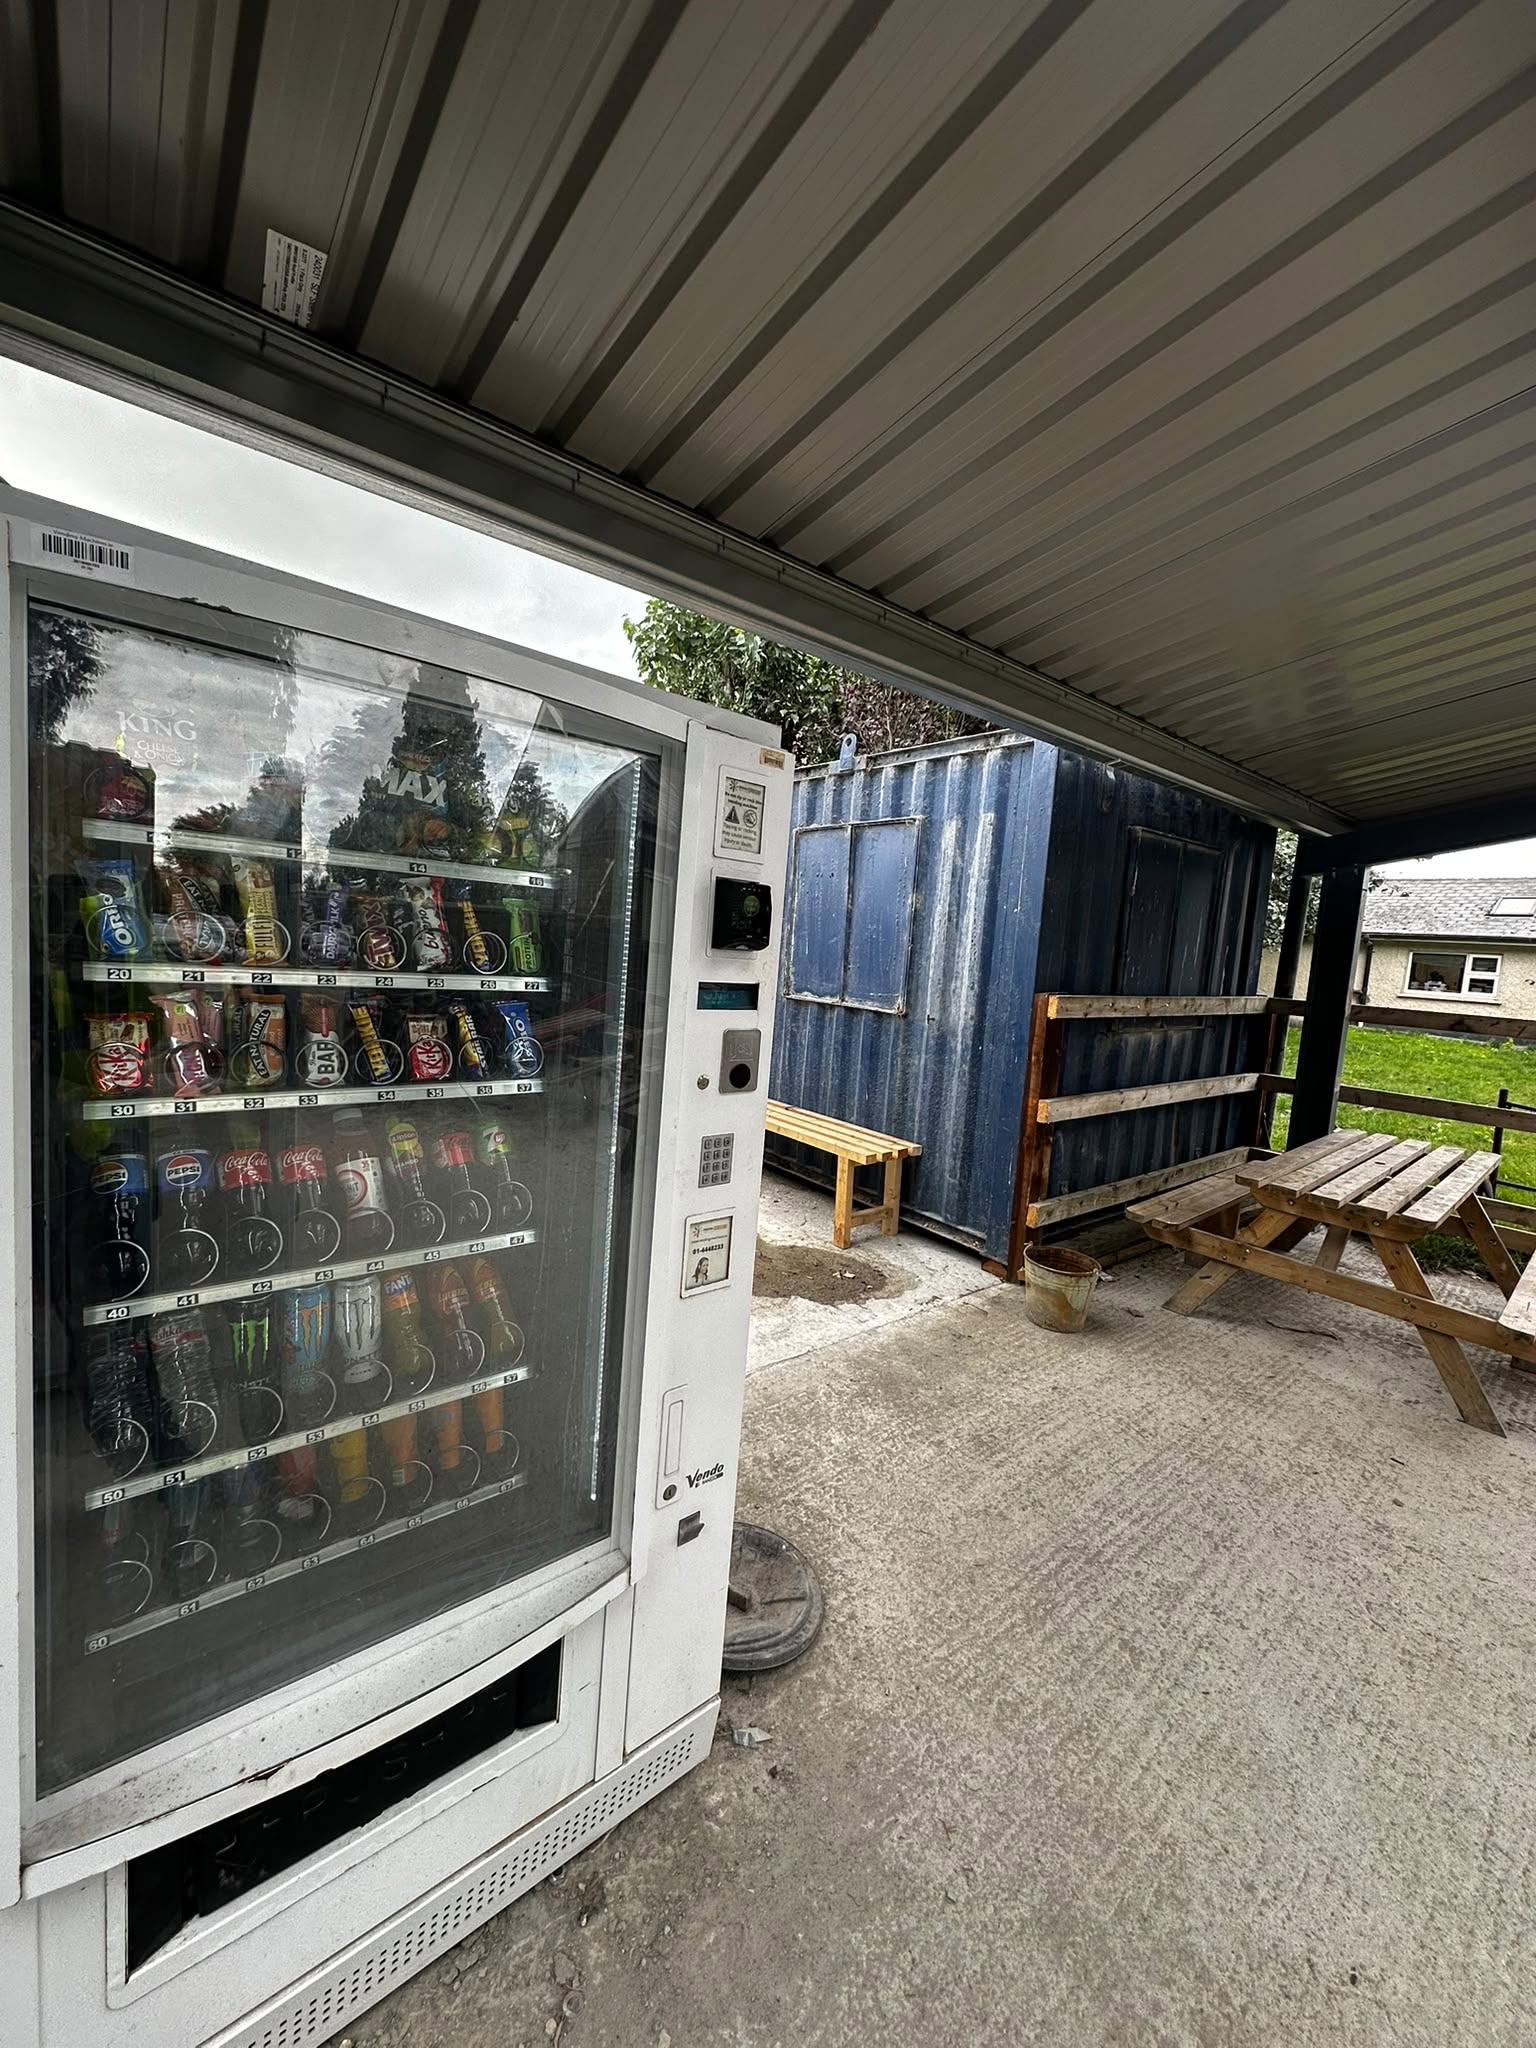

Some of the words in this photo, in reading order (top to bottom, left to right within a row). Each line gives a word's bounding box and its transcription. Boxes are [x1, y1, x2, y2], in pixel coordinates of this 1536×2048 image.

[116, 710, 197, 741] KING
[380, 767, 448, 807] MAX
[411, 864, 425, 873] 14
[183, 880, 202, 900] EAT
[364, 901, 393, 963] TWIX
[110, 969, 130, 979] 20
[184, 972, 203, 981] 21
[253, 974, 271, 983] 22
[319, 976, 335, 984] 23
[377, 977, 393, 986] 24
[429, 979, 444, 987] 25
[526, 982, 539, 990] 27
[252, 1057, 267, 1077] EAT
[479, 1086, 492, 1094] 36
[519, 1084, 531, 1092] 37
[379, 1092, 394, 1100] 34
[429, 1089, 443, 1097] 35
[245, 1099, 263, 1108] 32
[300, 1096, 317, 1104] 33
[113, 1106, 133, 1116] 30
[176, 1102, 195, 1112] 31
[167, 1166, 201, 1178] PEPSI
[511, 1236, 524, 1244] 47
[471, 1243, 484, 1251] 46
[426, 1252, 439, 1260] 45
[368, 1262, 383, 1270] 44
[316, 1272, 332, 1280] 43
[254, 1281, 271, 1291] 42
[384, 1274, 412, 1294] FANT
[178, 1296, 197, 1306] 41
[107, 1307, 128, 1318] 40
[505, 1374, 517, 1382] 57
[474, 1384, 486, 1392] 56
[411, 1402, 424, 1410] 55
[364, 1416, 378, 1424] 54
[308, 1432, 323, 1442] 53
[249, 1449, 266, 1458] 52
[165, 1474, 183, 1483] 51
[686, 1463, 724, 1488] Vendo
[103, 1491, 123, 1502] 50
[456, 1499, 469, 1508] 66
[408, 1518, 421, 1527] 65
[360, 1535, 374, 1545] 64
[303, 1556, 319, 1567] 63
[247, 1578, 263, 1589] 62
[180, 1603, 197, 1614] 61
[88, 1637, 108, 1650] 60
